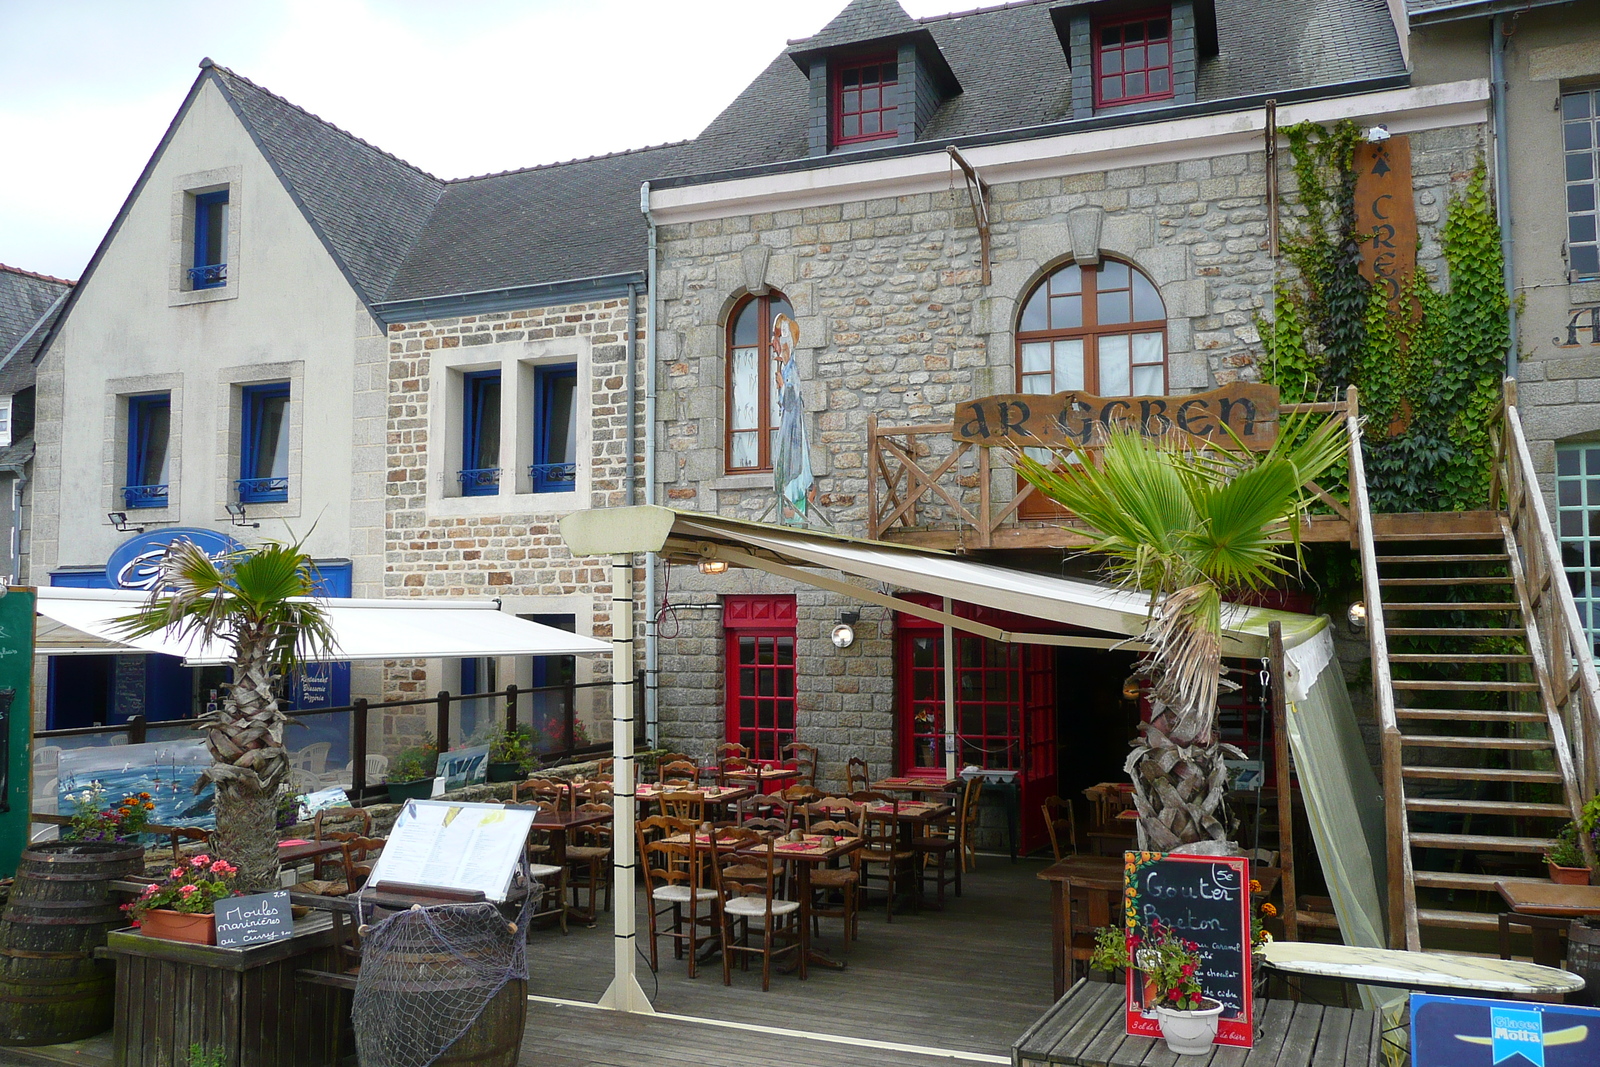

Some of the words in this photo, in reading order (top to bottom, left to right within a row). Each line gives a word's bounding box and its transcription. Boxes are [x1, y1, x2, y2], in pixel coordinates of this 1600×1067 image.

[226, 899, 279, 921] Moules
[220, 937, 237, 946] au
[1494, 1016, 1540, 1031] Glaces
[1494, 1027, 1541, 1043] Motta
